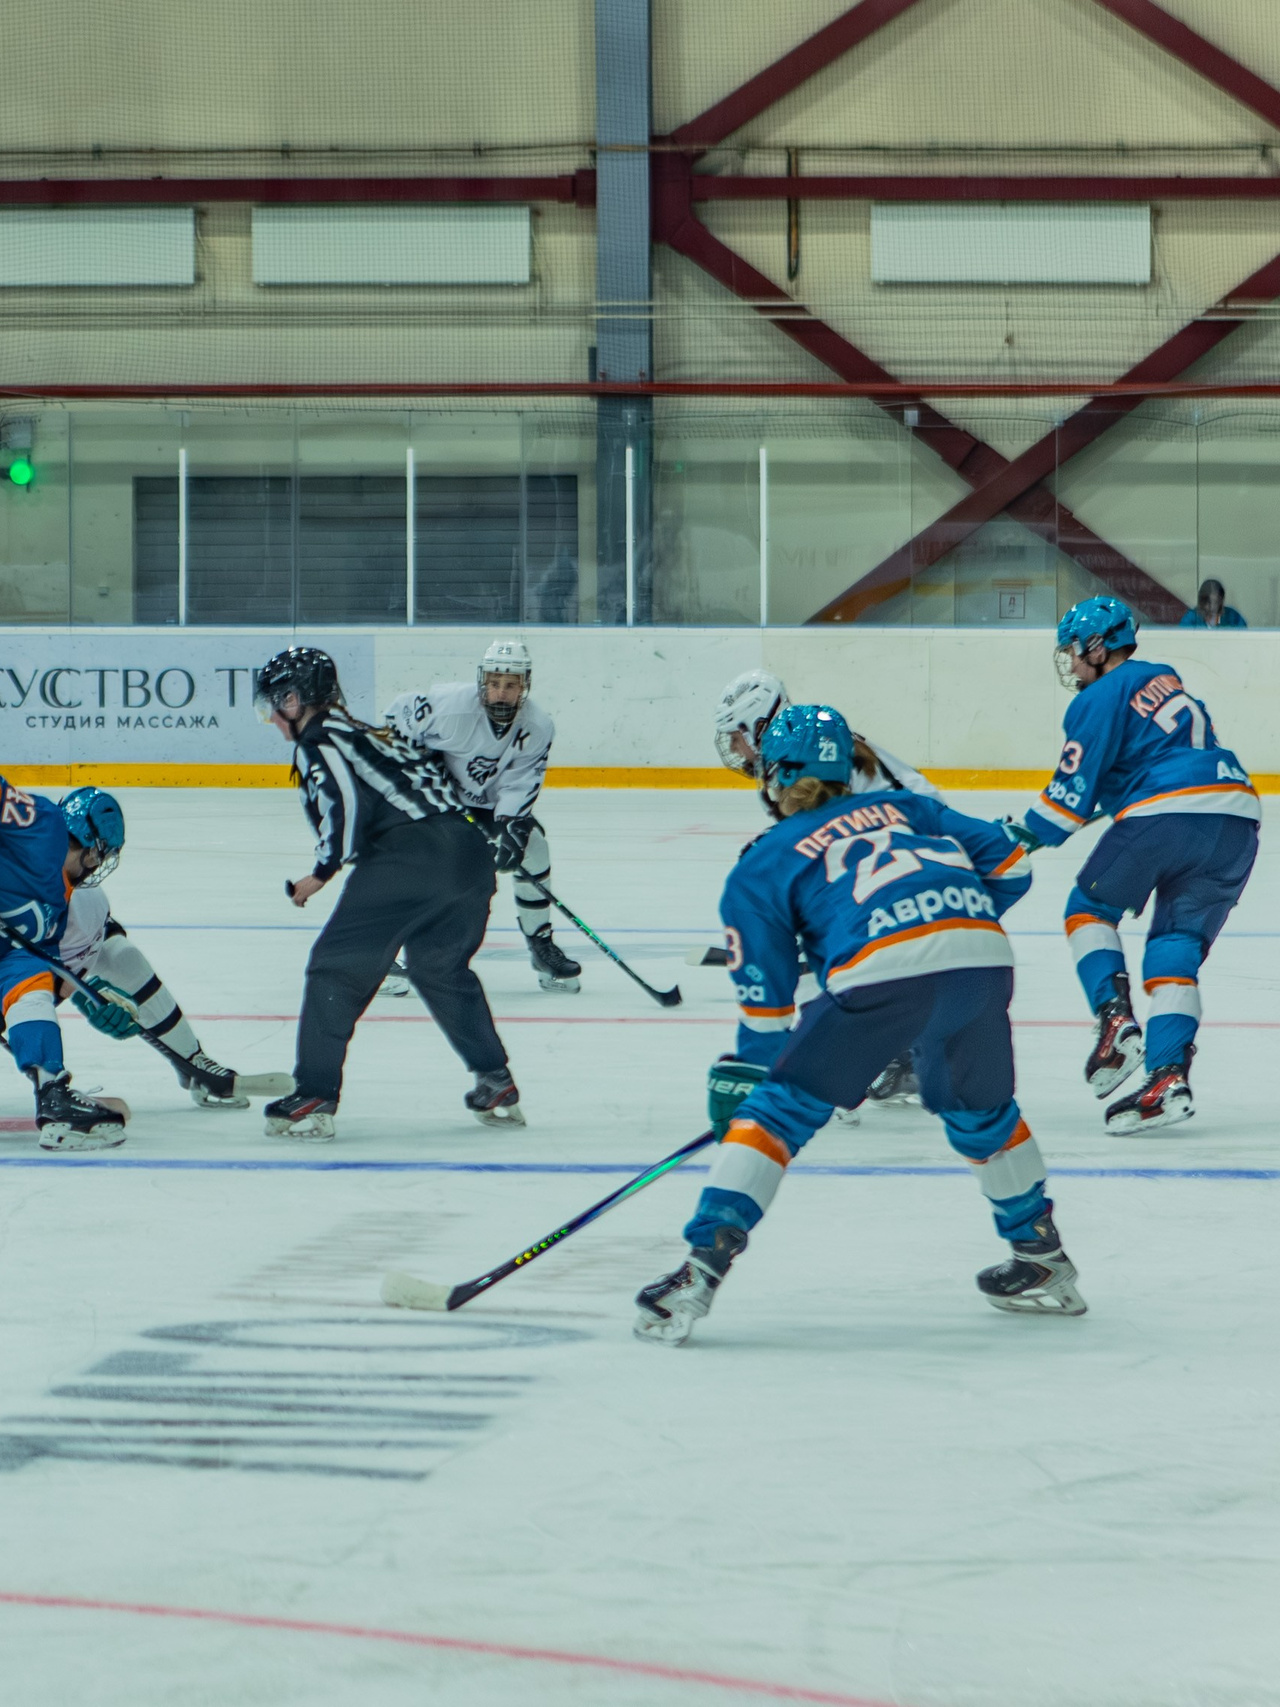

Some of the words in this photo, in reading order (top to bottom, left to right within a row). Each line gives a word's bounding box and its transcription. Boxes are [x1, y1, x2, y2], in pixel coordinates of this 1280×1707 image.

[25, 715, 106, 730] СТУДИЯ
[116, 715, 220, 728] МАССАЖА
[1152, 692, 1207, 751] 7
[818, 742, 838, 762] 23
[1059, 740, 1084, 775] 3
[794, 802, 910, 860] ПЕТИНА
[725, 926, 743, 972] 3
